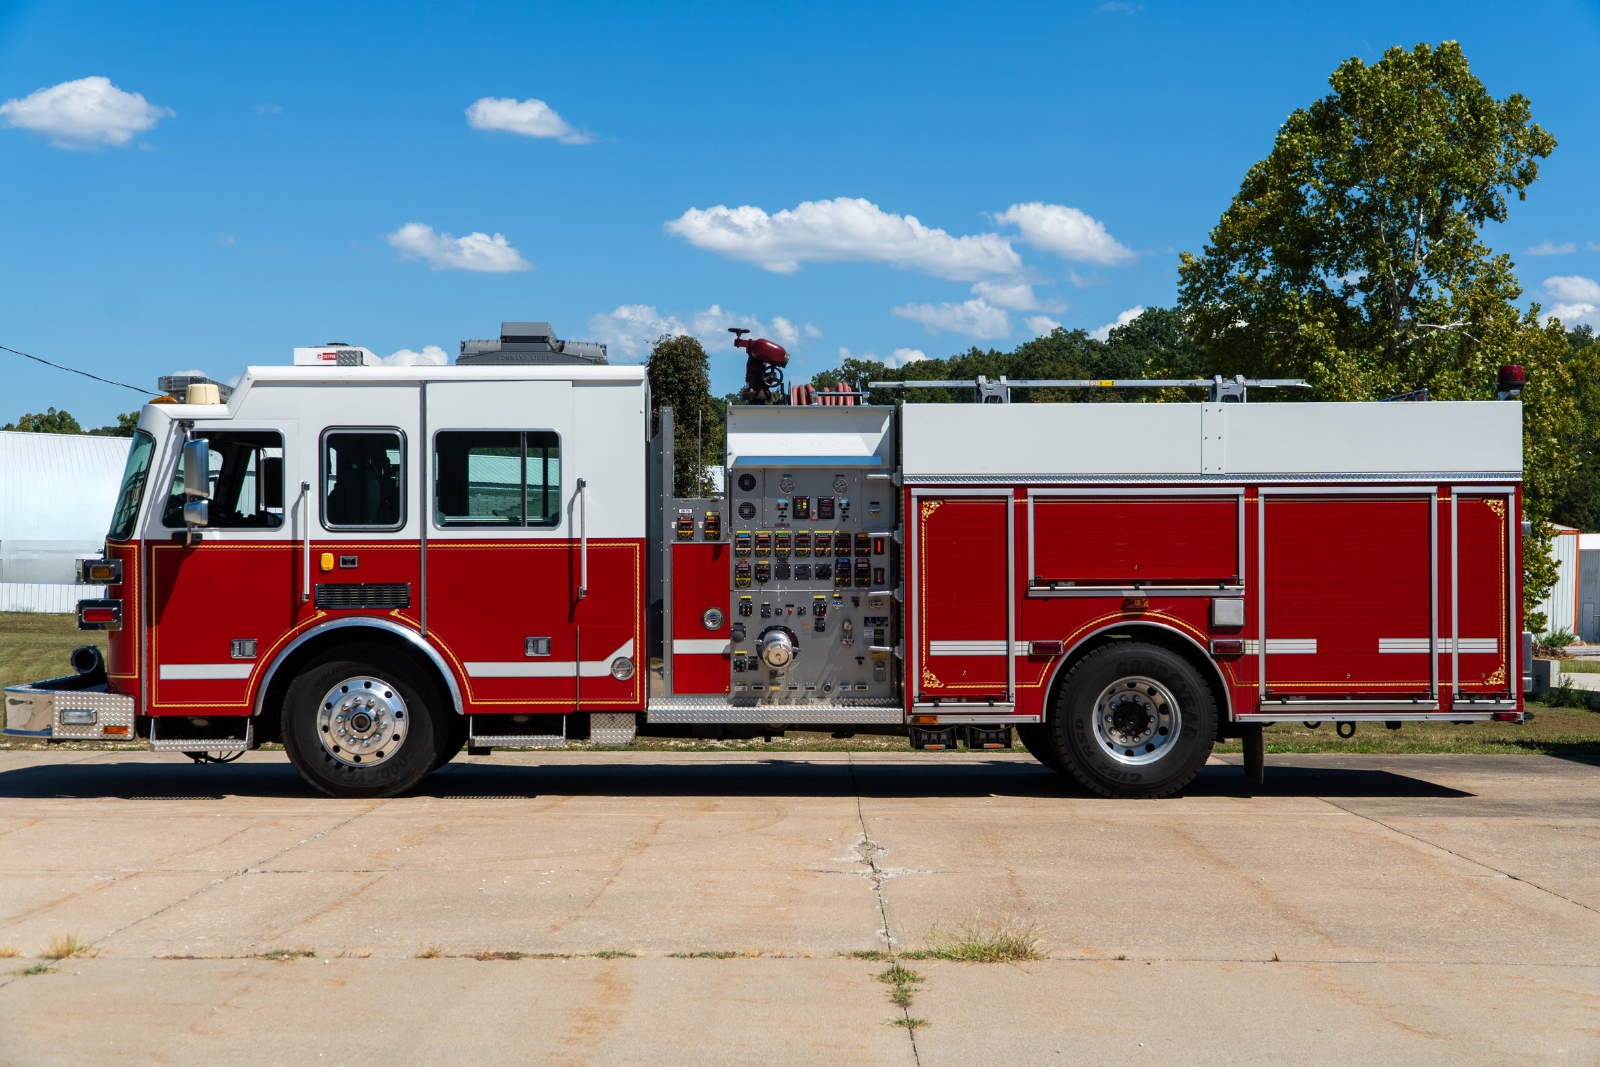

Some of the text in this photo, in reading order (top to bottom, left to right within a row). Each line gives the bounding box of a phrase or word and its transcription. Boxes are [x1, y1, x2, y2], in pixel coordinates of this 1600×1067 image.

[1115, 659, 1198, 741] GOODYEAR
[320, 746, 415, 783] GOODYEAR
[1075, 718, 1142, 783] G182 RSD
